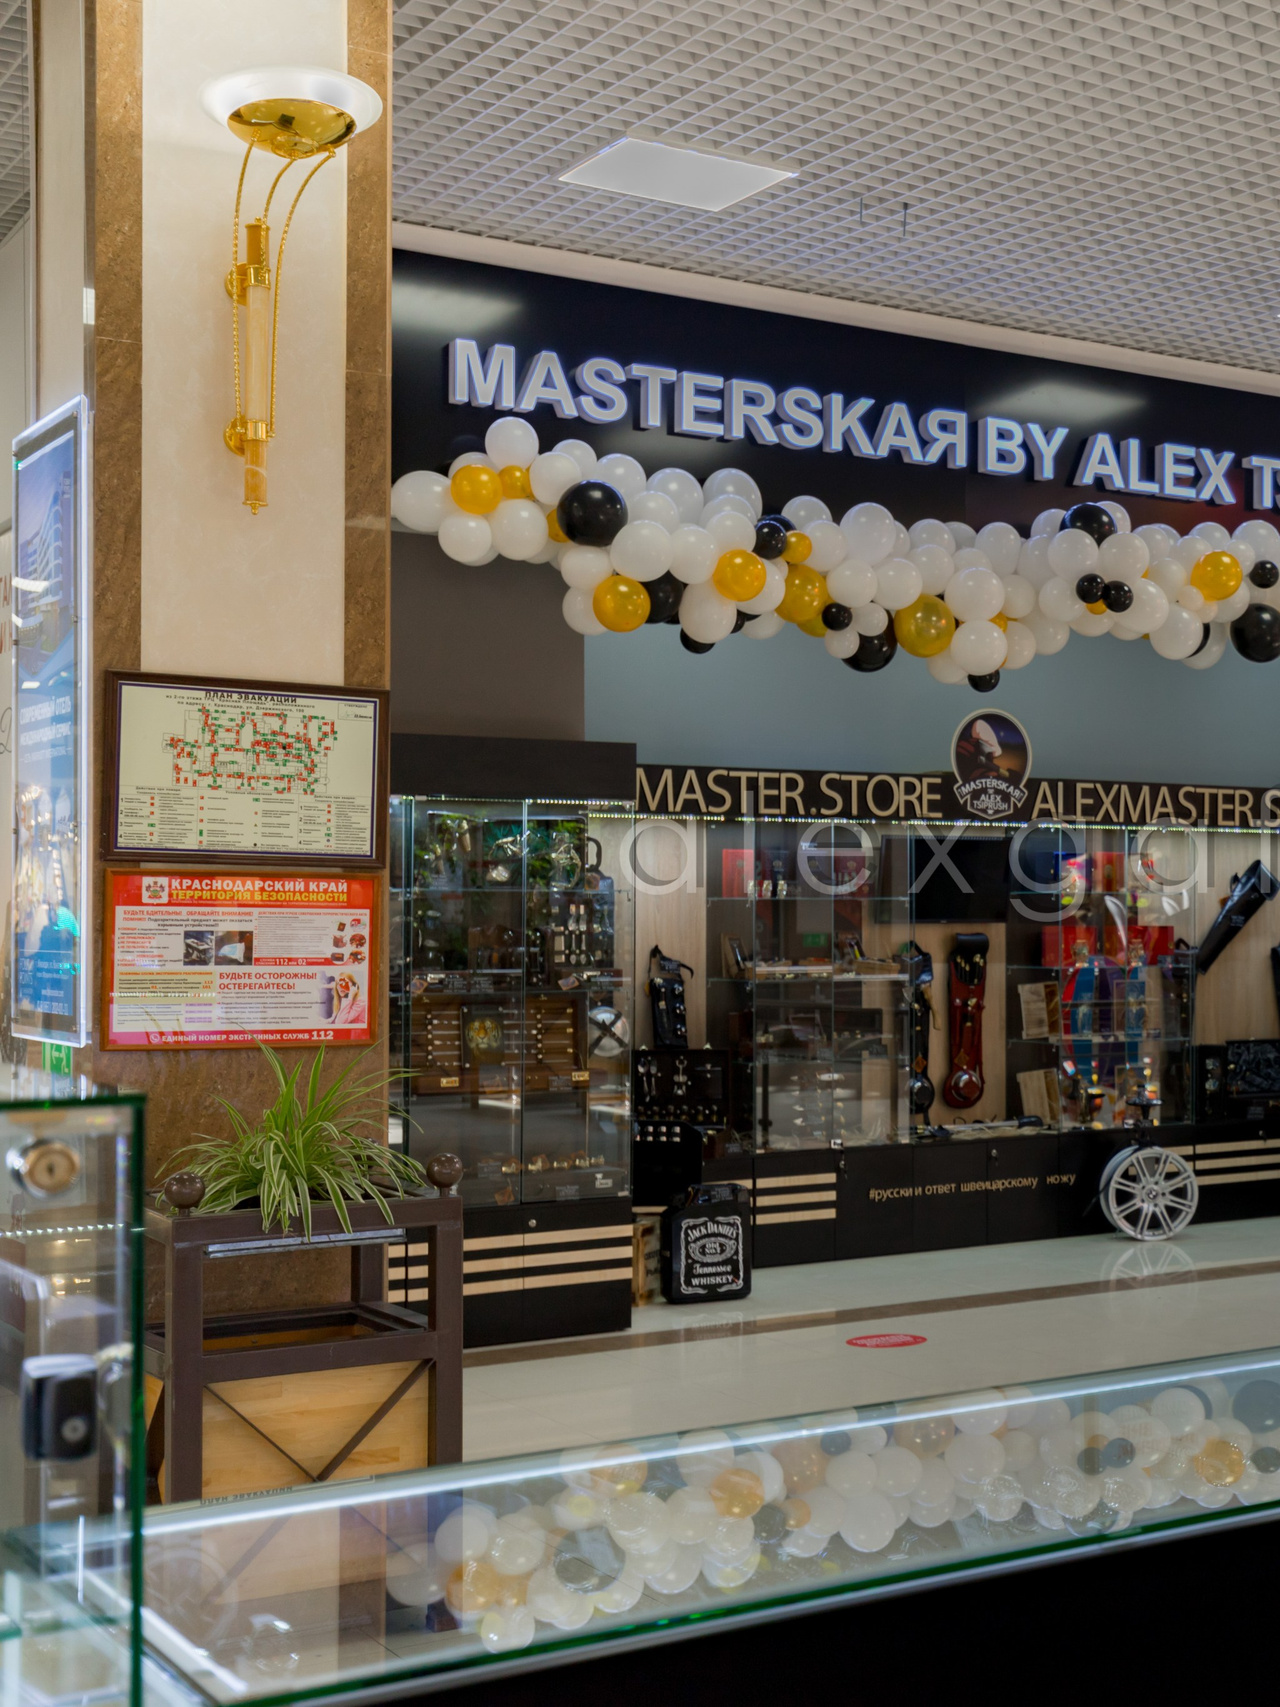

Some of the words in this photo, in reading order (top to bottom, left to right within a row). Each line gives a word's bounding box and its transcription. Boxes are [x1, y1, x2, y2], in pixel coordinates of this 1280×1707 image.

[978, 417, 1068, 482] BY
[1074, 433, 1236, 504] ALEX
[205, 691, 233, 700] ПЛАН
[237, 693, 297, 704] ЭВАКУАЦИИ
[979, 794, 1002, 804] ALEX
[973, 800, 1008, 811] TSIPRUSH
[171, 879, 306, 893] КРАСНОДАРСКИЙ
[309, 879, 348, 893] КРАЙ
[171, 890, 251, 901] ТЕРРИТОРИЯ
[254, 891, 348, 902] БЕЗОПАСНОСТИ
[186, 909, 220, 917] ОБРАЩАЙТЕ
[219, 972, 253, 981] БУДЬТЕ
[254, 972, 317, 980] ОСТОРОЖНЫ!
[218, 981, 296, 990] ОСТЕРЕГАЙТЕСЬ!
[162, 1032, 197, 1042] ЕДИНЫЙ
[311, 1030, 334, 1040] 112
[925, 1183, 957, 1196] ответ
[1046, 1174, 1076, 1186] ножу
[687, 1225, 708, 1242] JACK
[692, 1263, 732, 1275] Tennessee
[691, 1275, 733, 1286] WHISKEY
